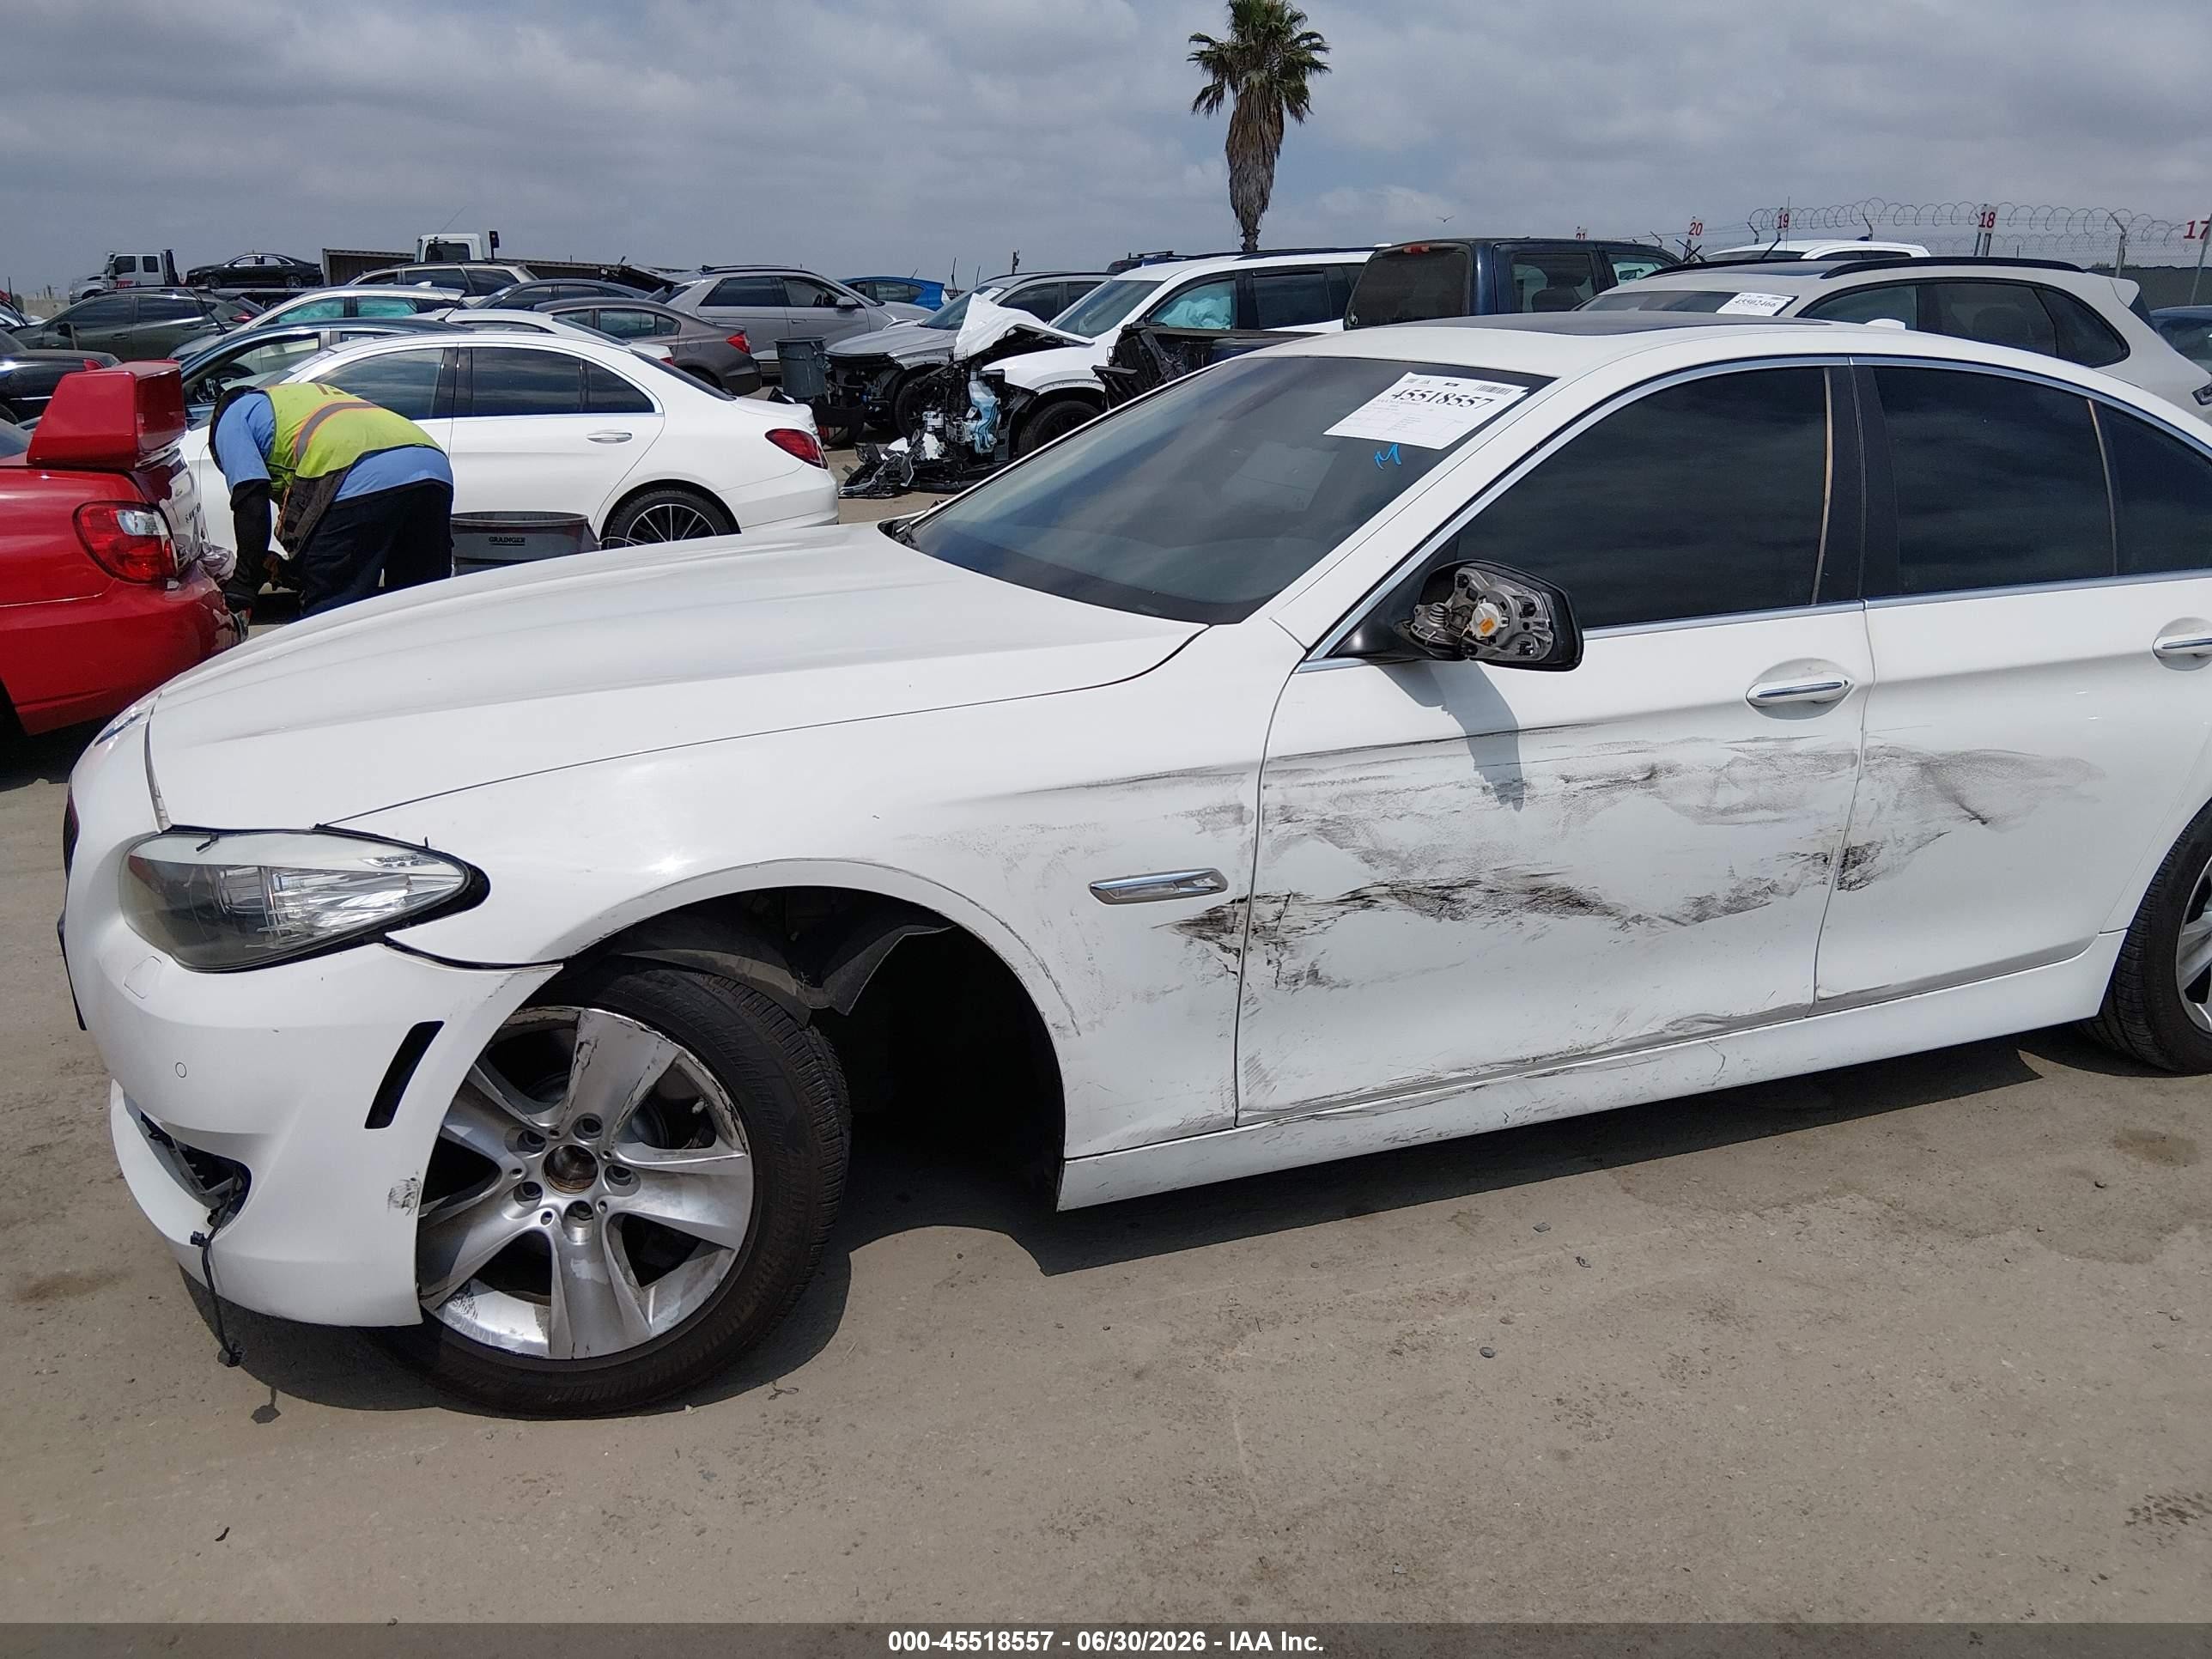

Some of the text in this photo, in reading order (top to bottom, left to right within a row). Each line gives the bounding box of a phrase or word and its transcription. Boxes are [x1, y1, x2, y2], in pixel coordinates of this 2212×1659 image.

[1778, 213, 1790, 229] 19
[1978, 211, 1996, 228] 18
[1688, 222, 1703, 236] 20
[2184, 220, 2210, 240] 17
[1391, 388, 1495, 409] 45518557
[1374, 442, 1402, 470] M
